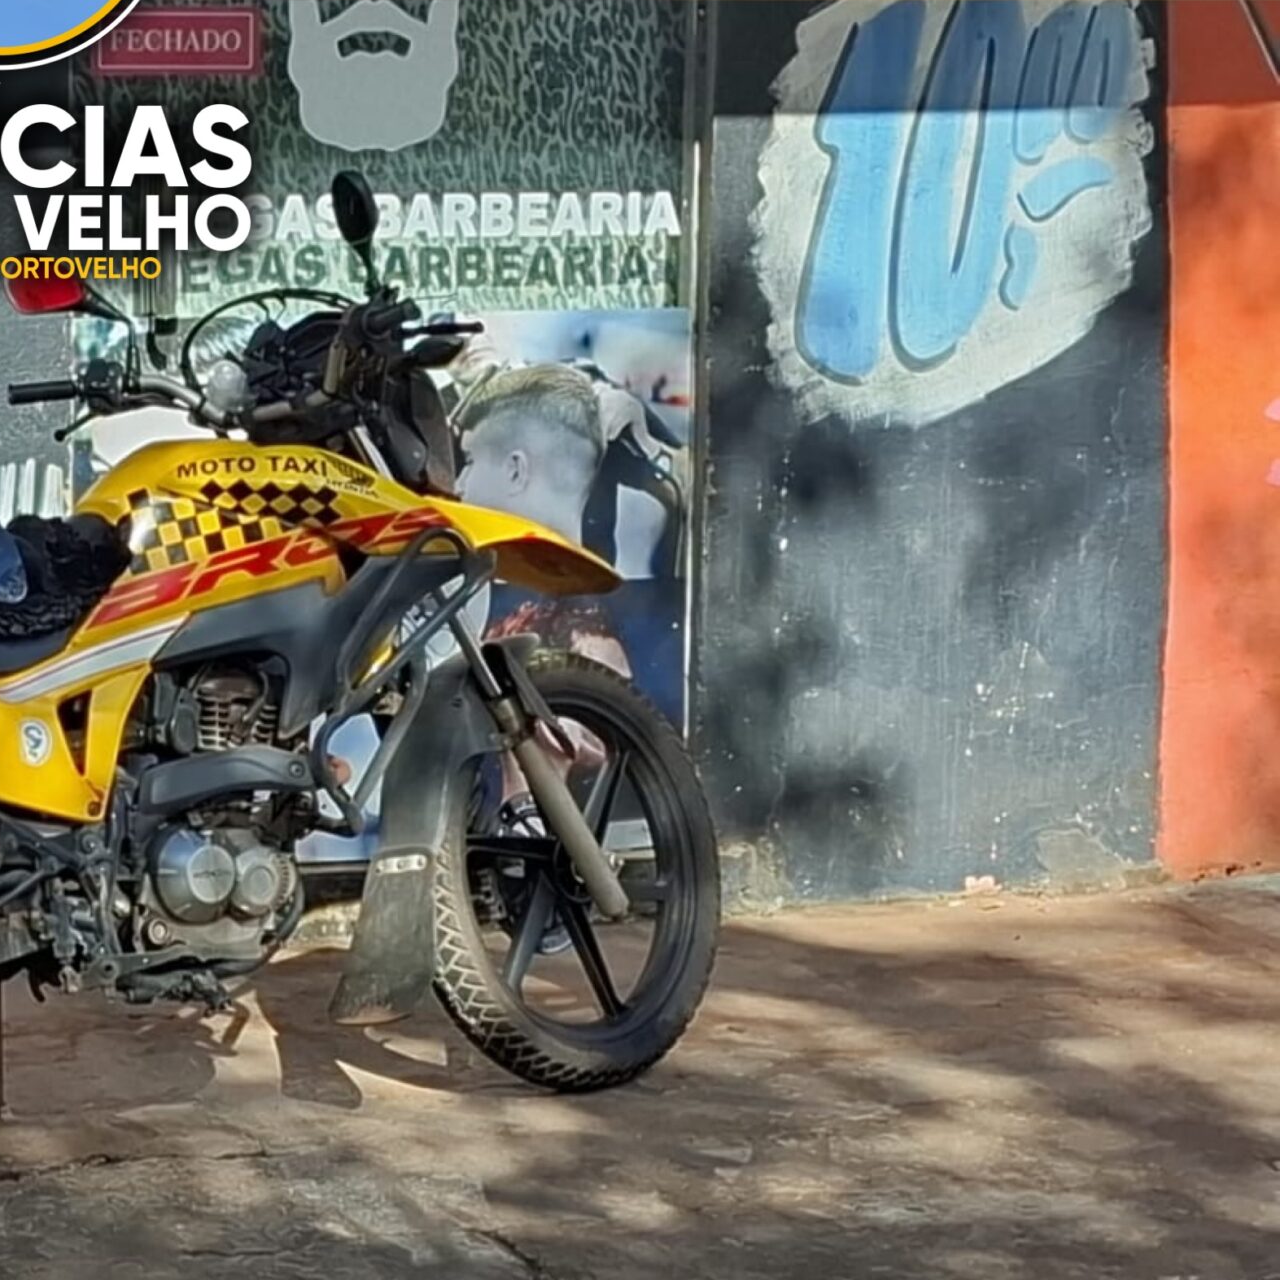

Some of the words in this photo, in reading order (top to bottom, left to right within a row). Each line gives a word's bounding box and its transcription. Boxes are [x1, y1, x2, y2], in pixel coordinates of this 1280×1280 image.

[110, 27, 242, 53] FECHADO
[371, 190, 682, 238] BARBEARIA
[177, 456, 256, 478] MOTO
[264, 455, 328, 477] TAXI
